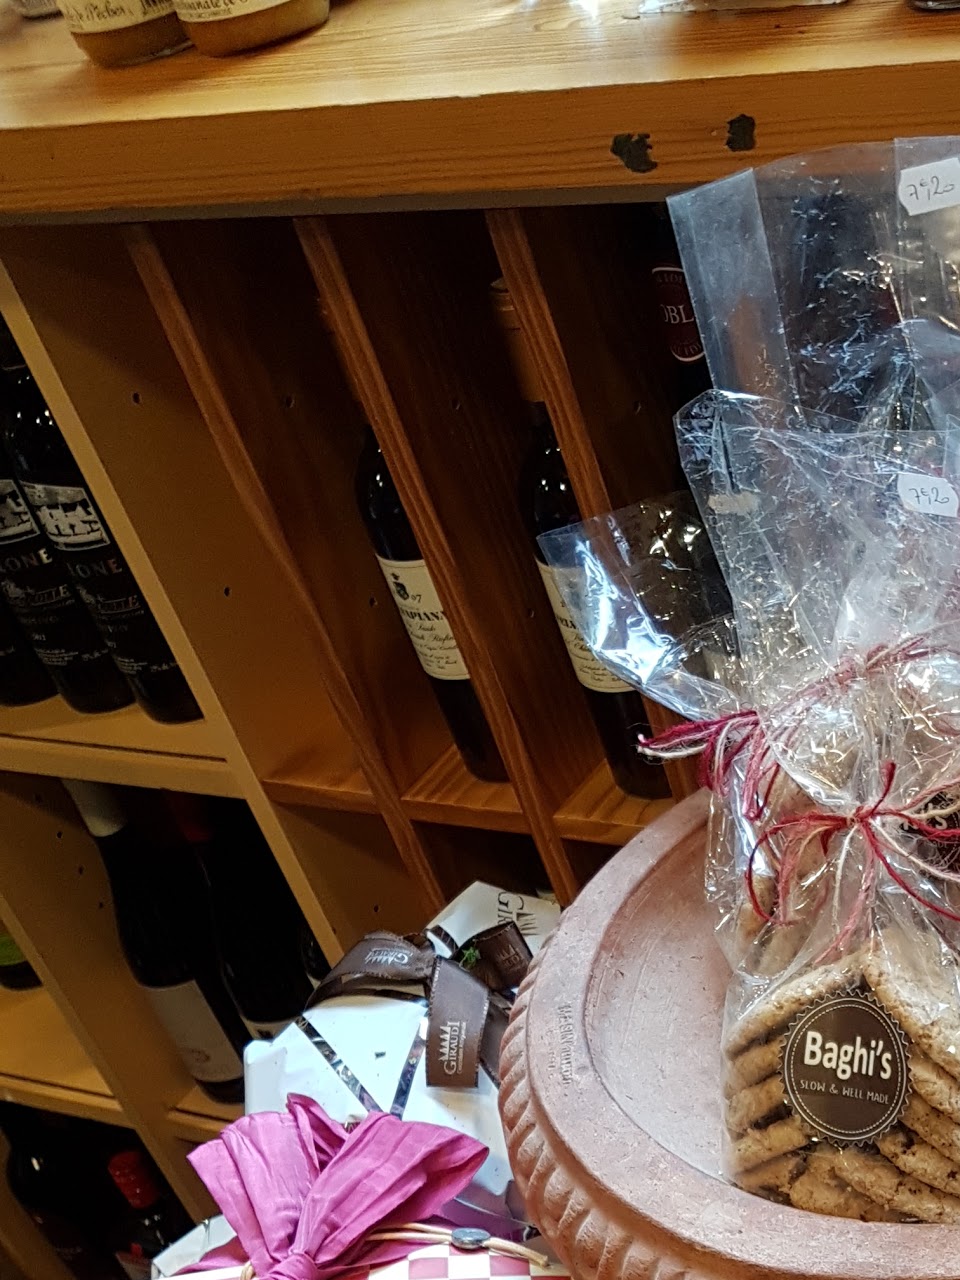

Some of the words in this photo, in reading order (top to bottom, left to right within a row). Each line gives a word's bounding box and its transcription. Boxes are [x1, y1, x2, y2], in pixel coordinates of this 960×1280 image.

[443, 1020, 461, 1075] GIRAUDI
[803, 1030, 892, 1080] Baghi's
[800, 1079, 826, 1092] SLOW
[829, 1083, 839, 1095] &
[842, 1086, 863, 1099] WELL
[866, 1091, 890, 1105] MADE
